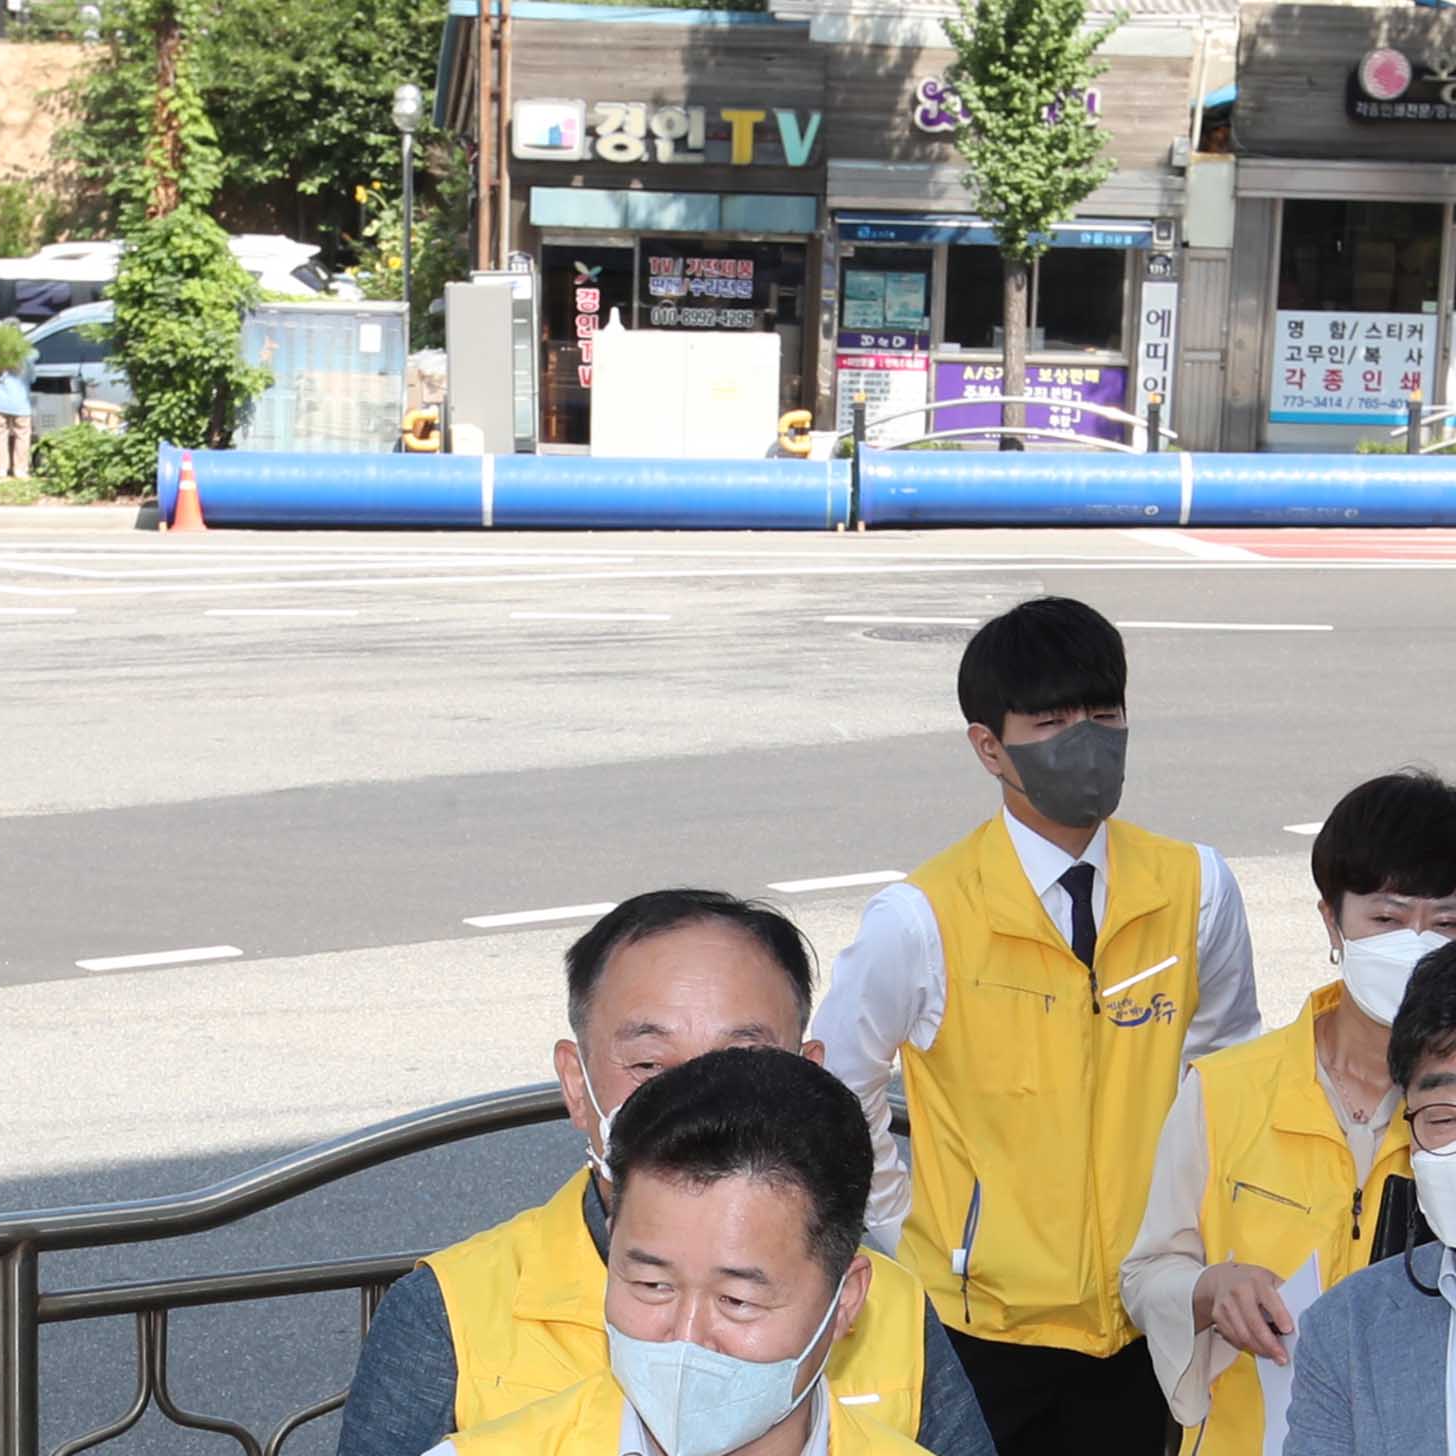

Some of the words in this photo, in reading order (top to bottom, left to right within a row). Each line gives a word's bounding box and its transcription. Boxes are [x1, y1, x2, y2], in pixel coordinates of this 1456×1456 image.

[593, 101, 706, 164] 경인
[720, 106, 823, 166] TV
[1364, 323, 1424, 342] 스티커
